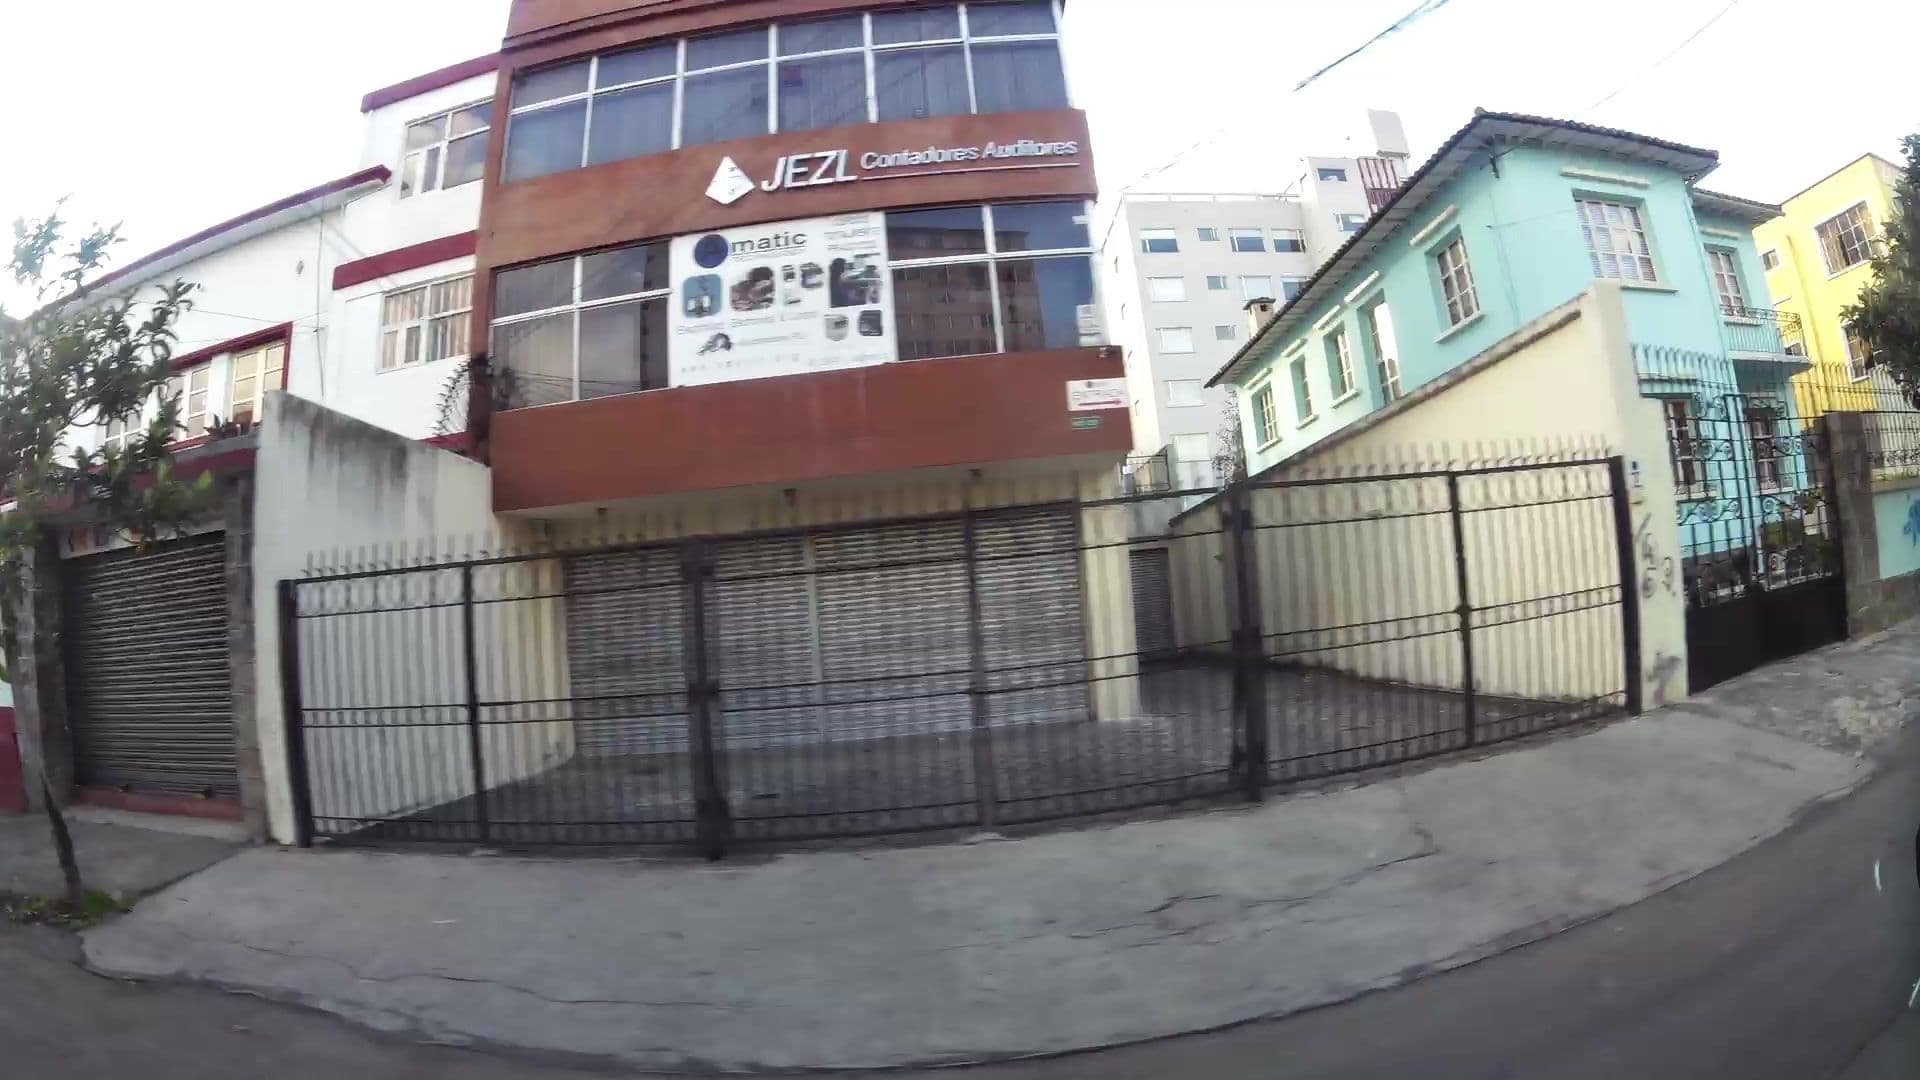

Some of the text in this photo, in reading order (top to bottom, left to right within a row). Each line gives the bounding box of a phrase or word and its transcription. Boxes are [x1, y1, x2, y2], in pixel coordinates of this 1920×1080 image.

[761, 139, 1079, 191] JEZL Contadores Auditores
